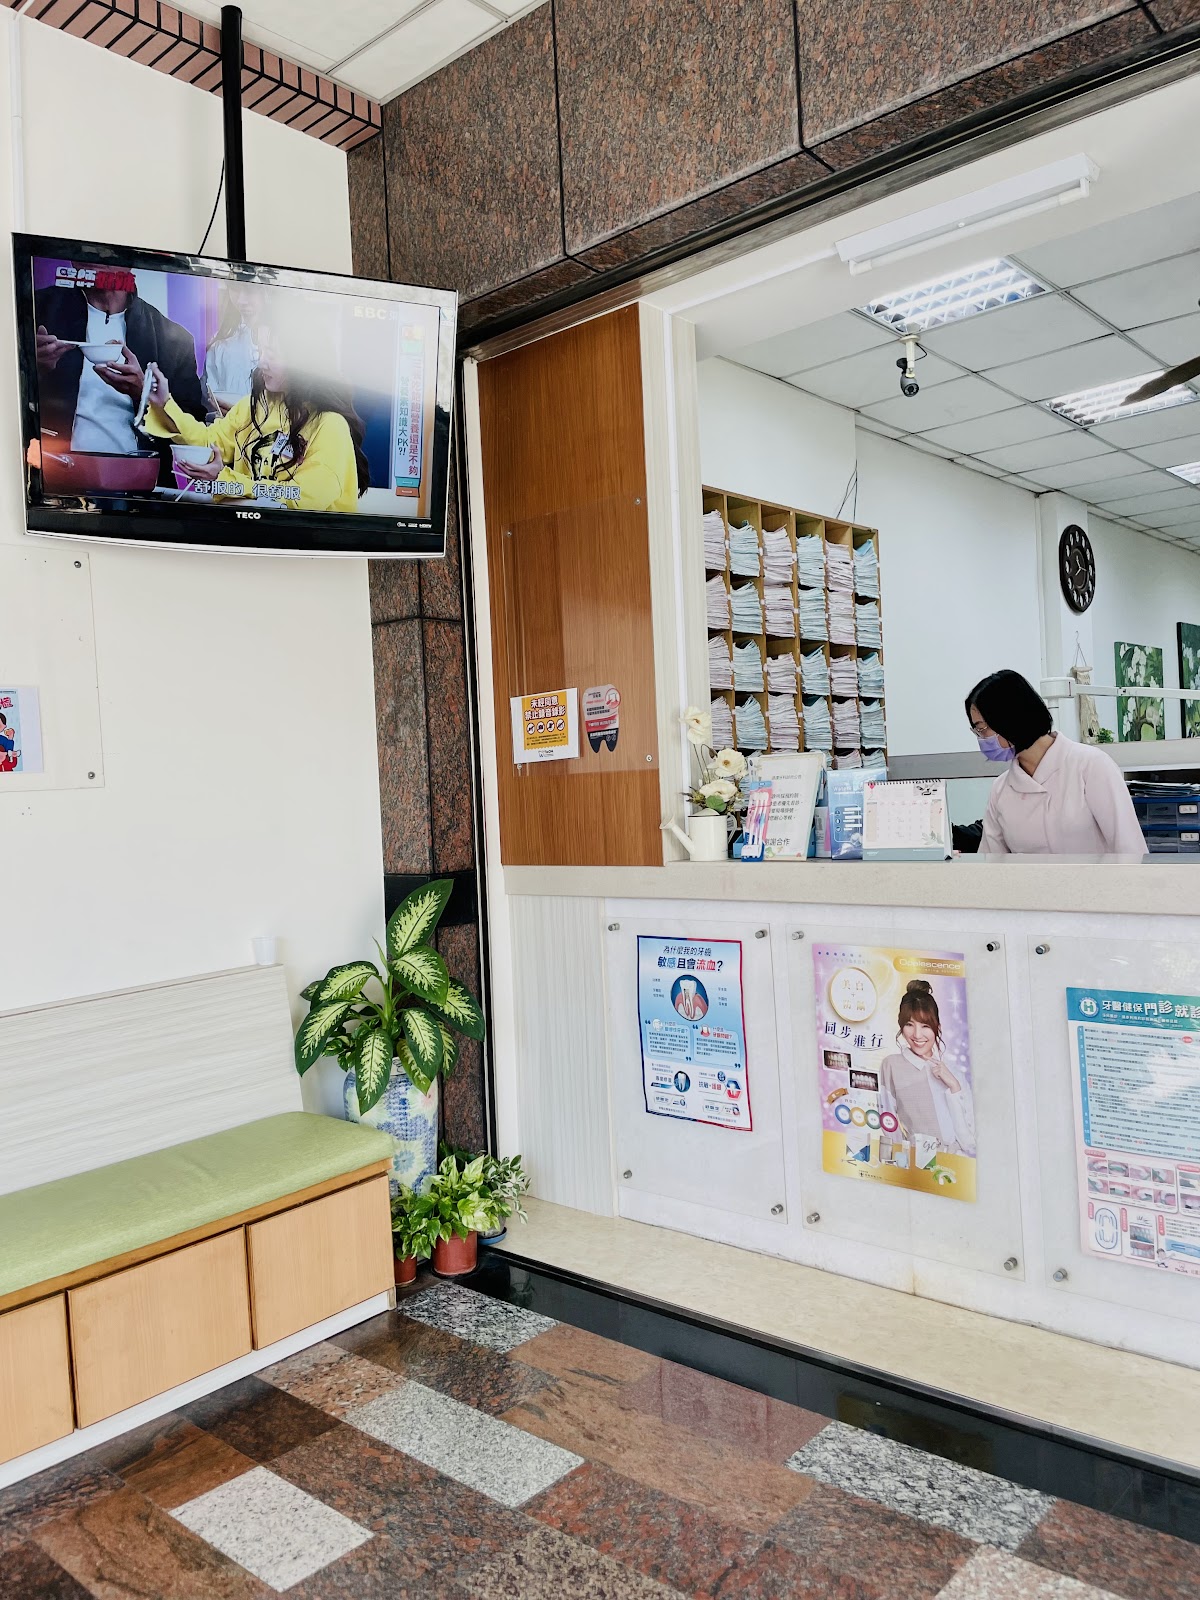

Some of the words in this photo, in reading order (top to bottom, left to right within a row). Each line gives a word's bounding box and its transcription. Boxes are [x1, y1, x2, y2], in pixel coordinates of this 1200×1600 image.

[194, 479, 244, 495] 舒服的
[252, 483, 301, 500] 很舒服
[236, 511, 261, 519] TECO
[530, 695, 559, 709] 未經同意
[524, 705, 566, 720] 禁止錄音錄影
[657, 956, 724, 971] 敏感且會流血?
